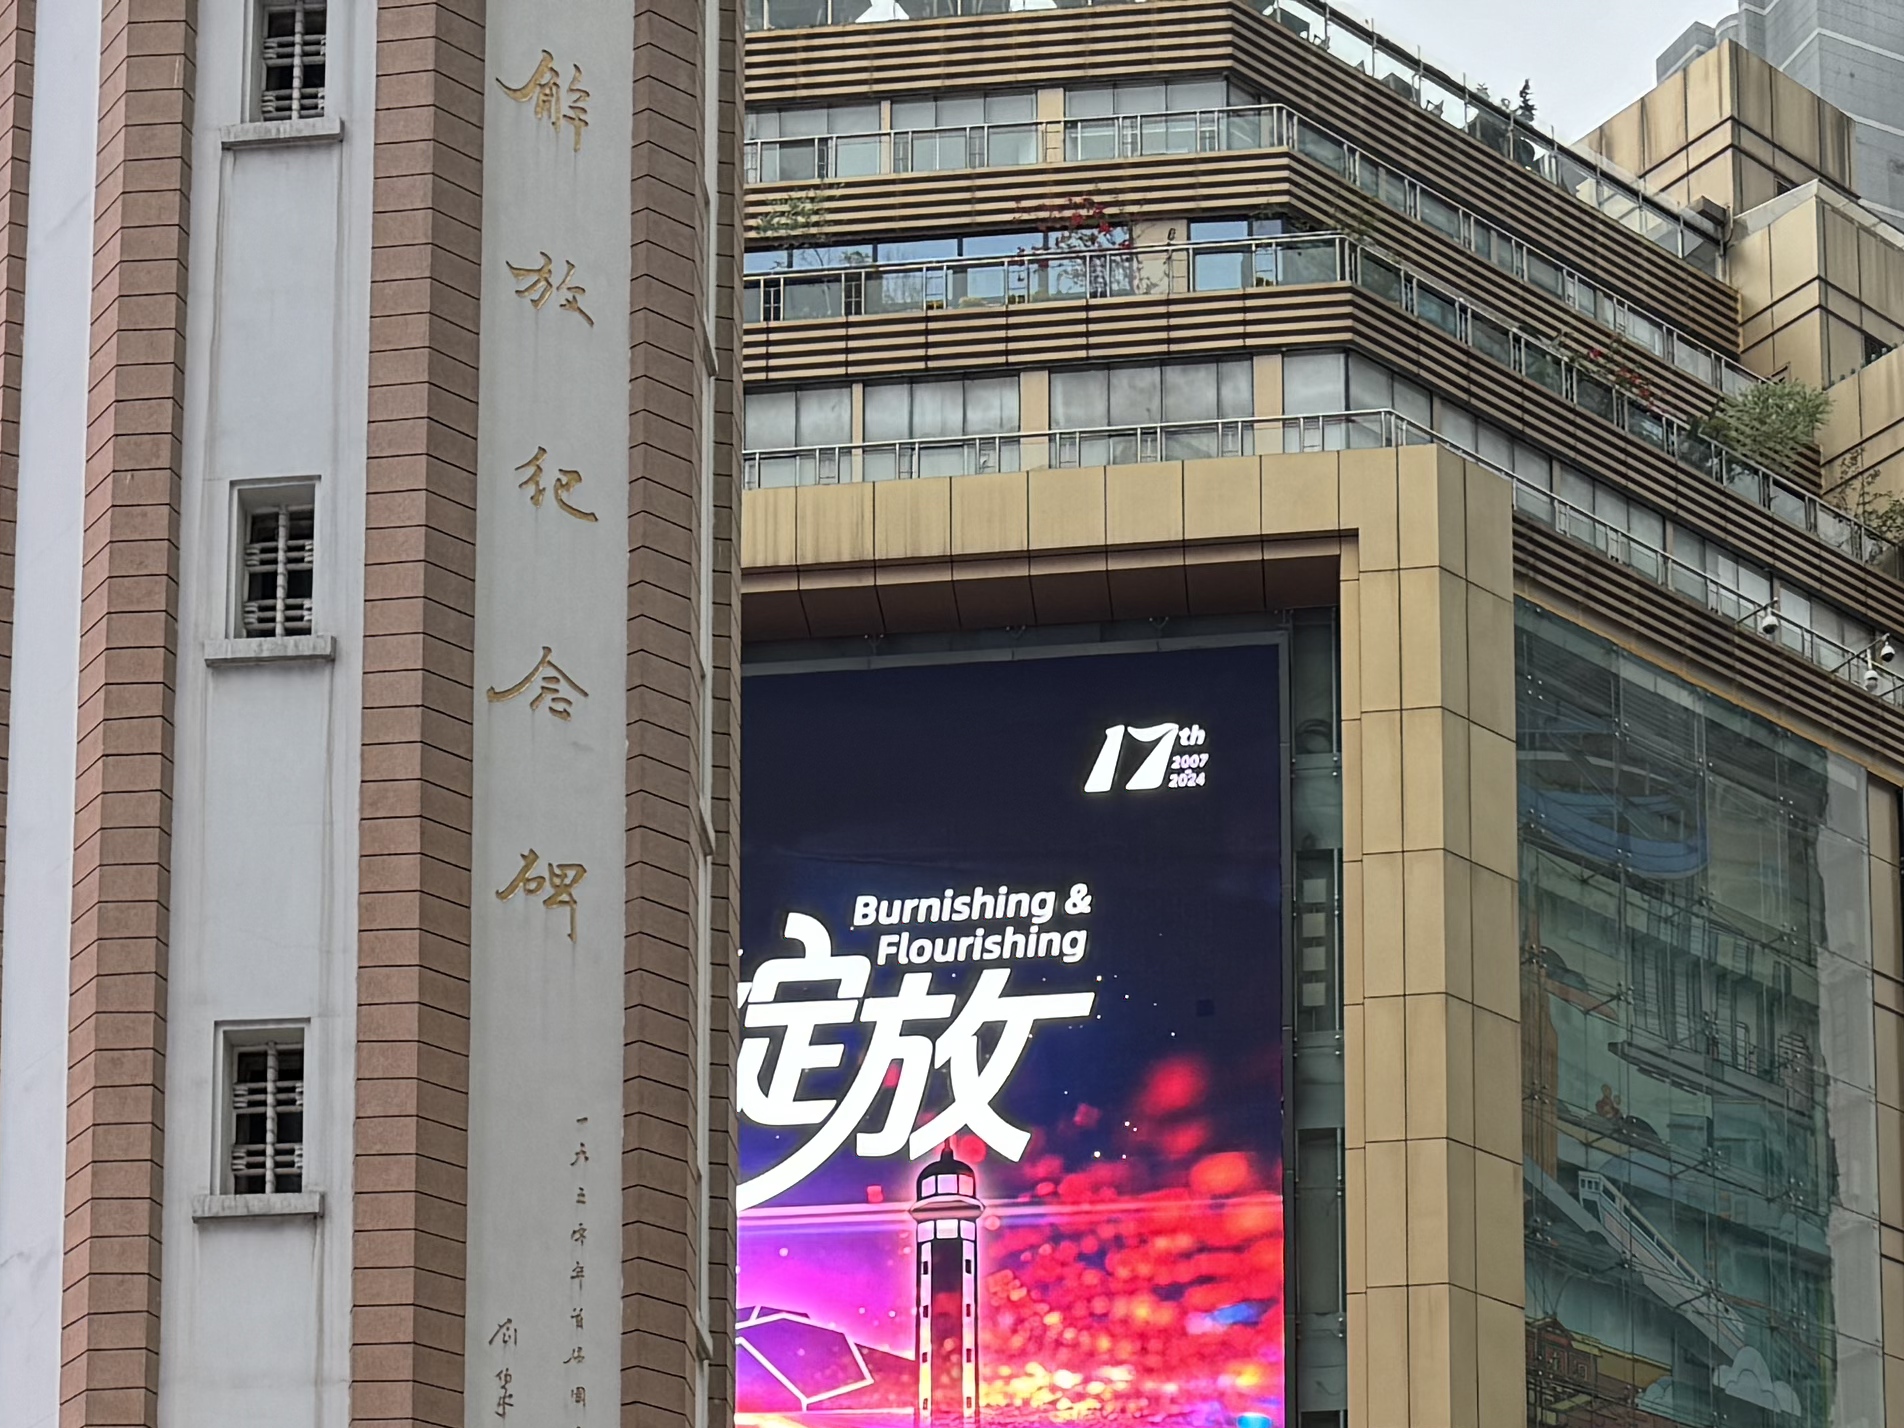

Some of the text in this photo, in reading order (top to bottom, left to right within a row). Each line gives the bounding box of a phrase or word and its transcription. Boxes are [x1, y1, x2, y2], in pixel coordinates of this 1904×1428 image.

[852, 881, 1093, 929] Burnishing &
[876, 924, 1089, 967] Flourishing
